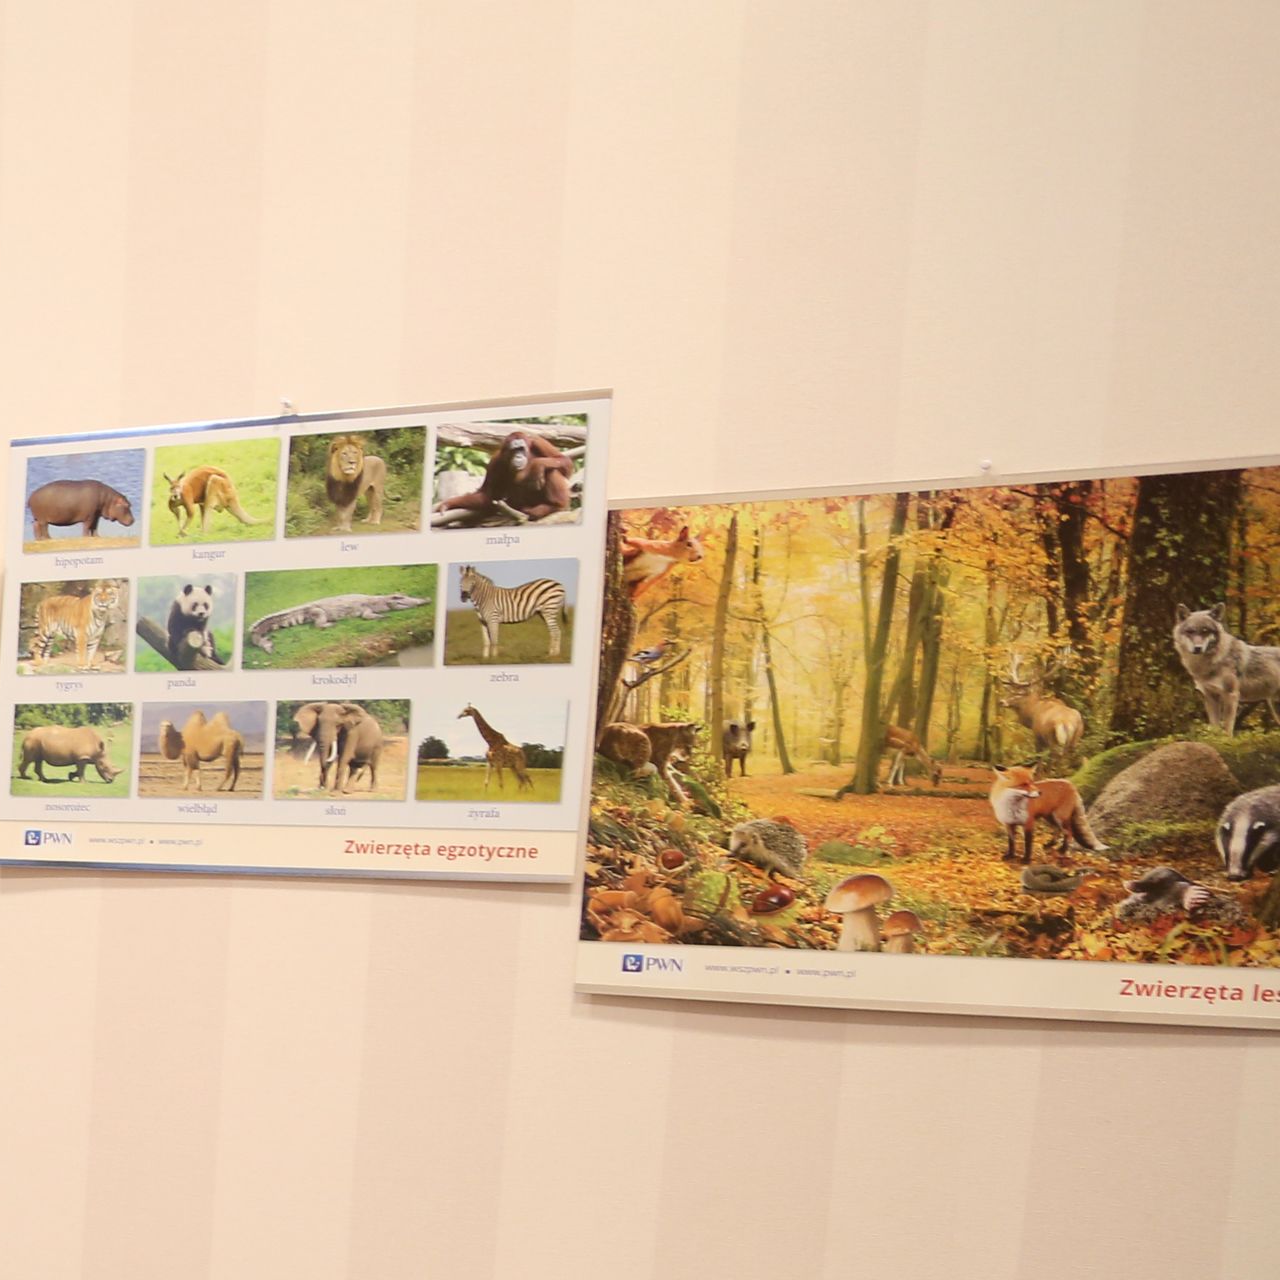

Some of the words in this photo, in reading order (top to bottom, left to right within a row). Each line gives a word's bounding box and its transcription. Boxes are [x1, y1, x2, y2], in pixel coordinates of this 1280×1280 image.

[341, 541, 359, 552] lew
[486, 533, 520, 547] małpa
[55, 556, 104, 568] hipopotam
[192, 549, 227, 562] kangur
[167, 677, 196, 689] panda
[311, 673, 357, 687] krokodyl
[490, 671, 520, 682] zebra
[56, 680, 84, 692] tygrys
[43, 832, 72, 845] PWN
[344, 840, 431, 859] Zwierzęta
[437, 844, 539, 861] egzotyczne
[646, 957, 683, 972] PWN
[1119, 979, 1244, 1004] Zwierzęta
